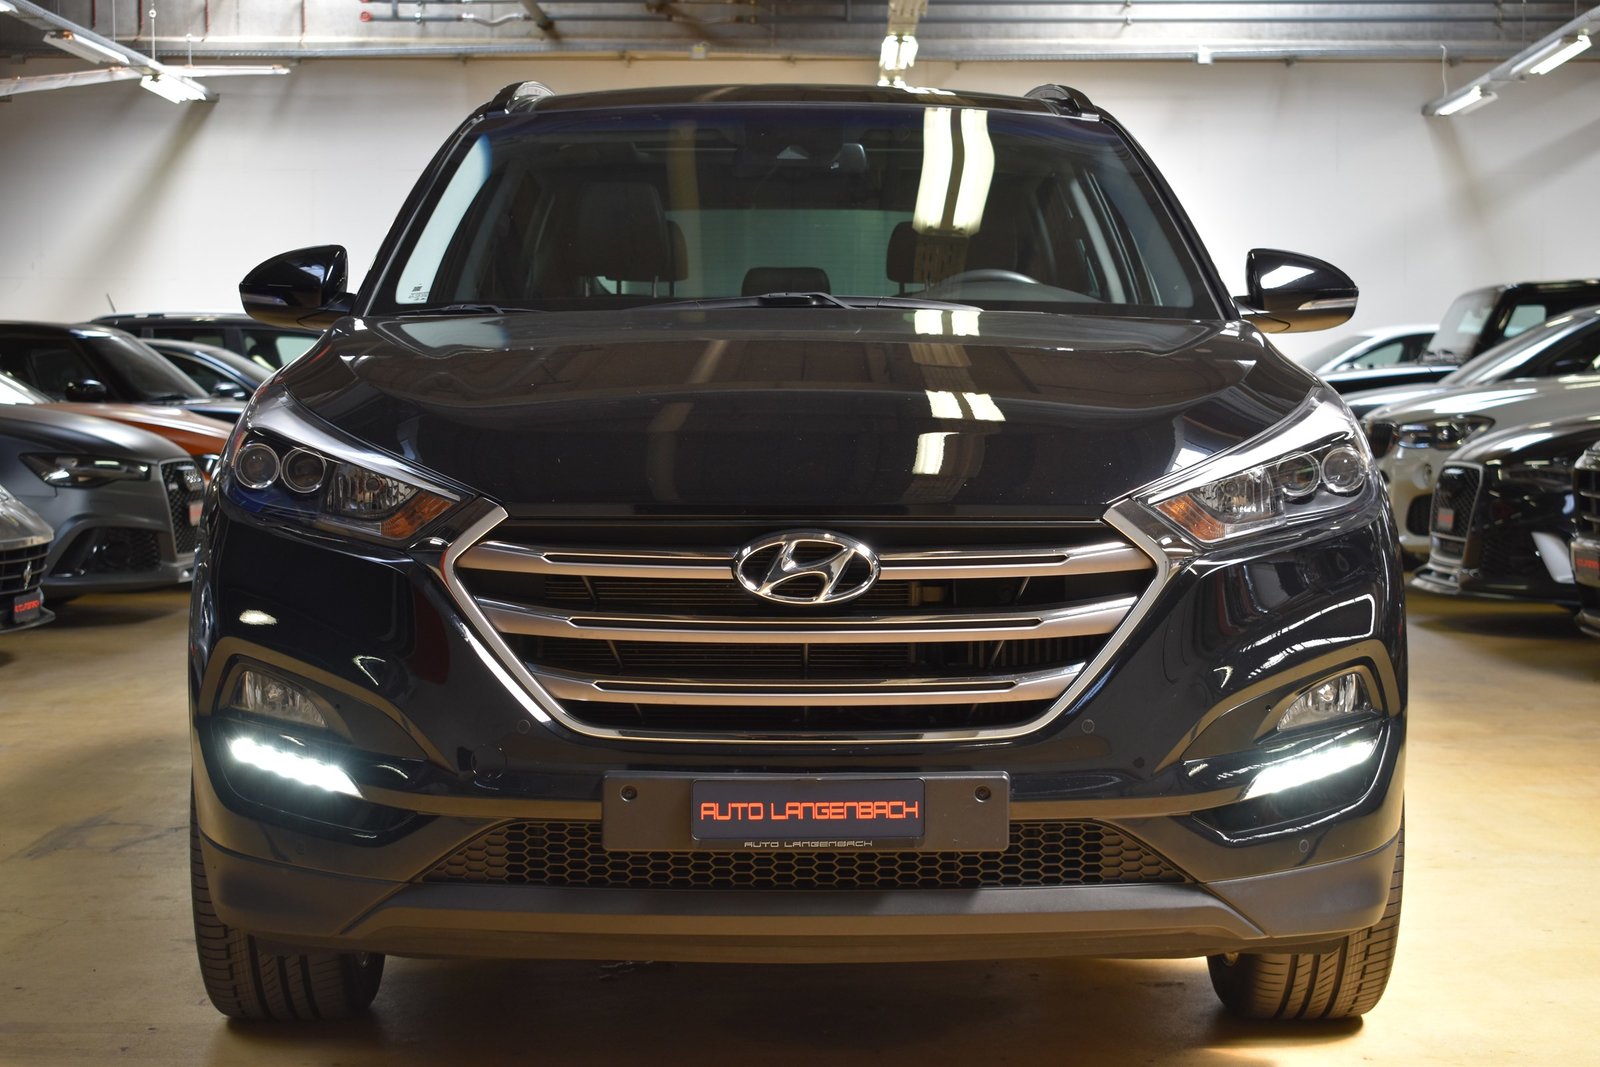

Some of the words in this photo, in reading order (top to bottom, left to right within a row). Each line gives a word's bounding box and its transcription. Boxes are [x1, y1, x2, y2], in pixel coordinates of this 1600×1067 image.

[700, 802, 764, 821] AUTO
[770, 801, 919, 820] LANGENBACH
[783, 840, 873, 848] LANGENBACH
